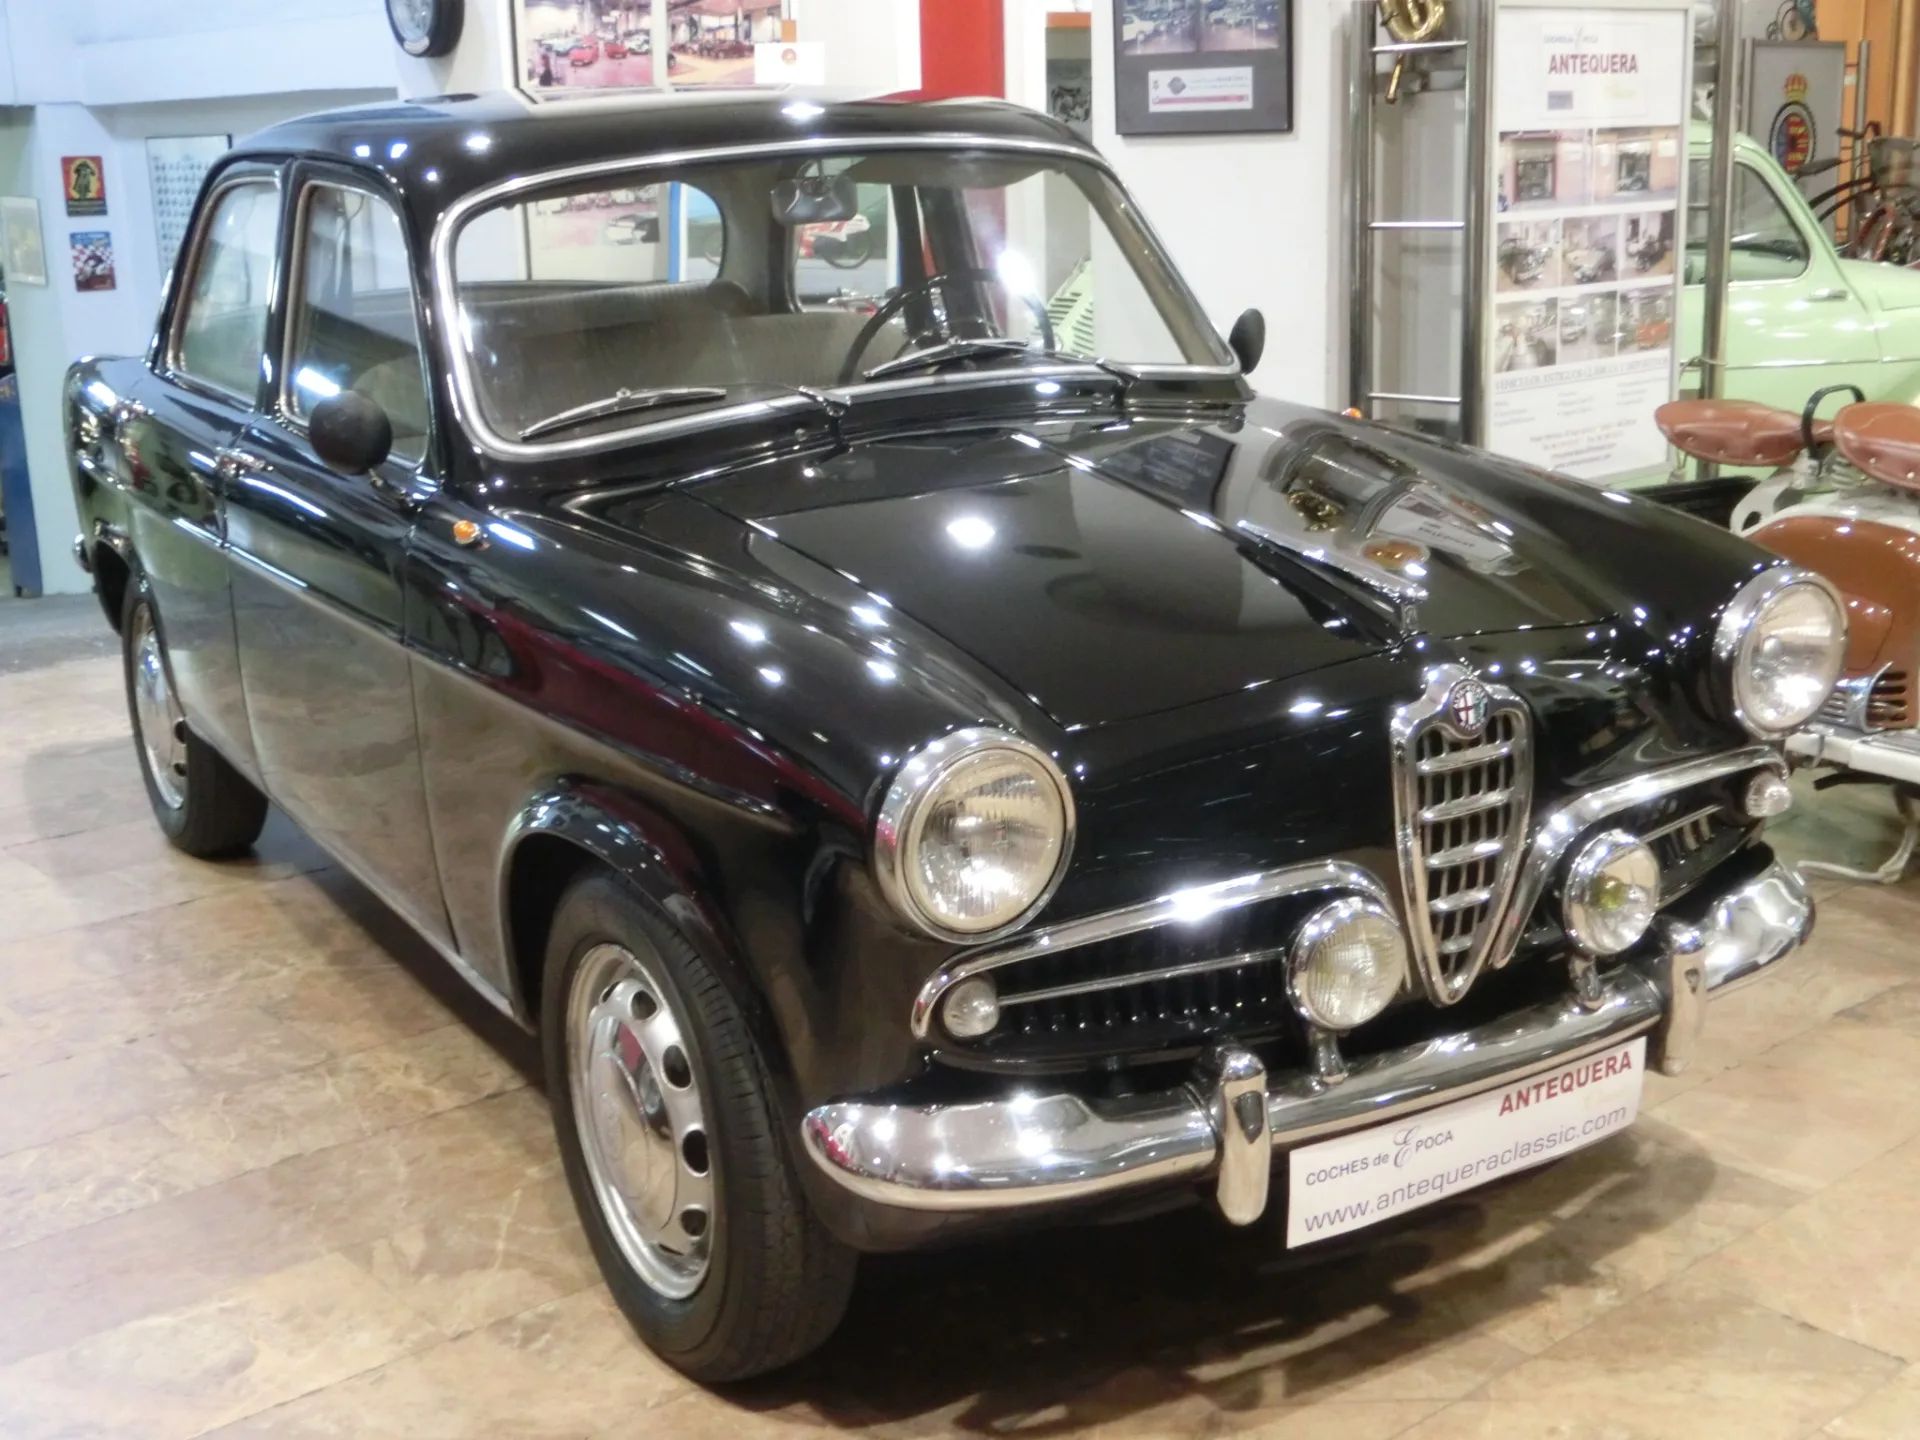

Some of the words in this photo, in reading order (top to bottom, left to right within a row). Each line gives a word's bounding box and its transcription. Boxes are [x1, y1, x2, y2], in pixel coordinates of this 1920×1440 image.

[1548, 53, 1639, 74] ANTEQUERA
[1498, 1051, 1632, 1117] ANTEQUERA
[1305, 1106, 1627, 1232] www.antequeraclassic.com
[1306, 1158, 1369, 1186] COCHES
[1372, 1153, 1390, 1167] de
